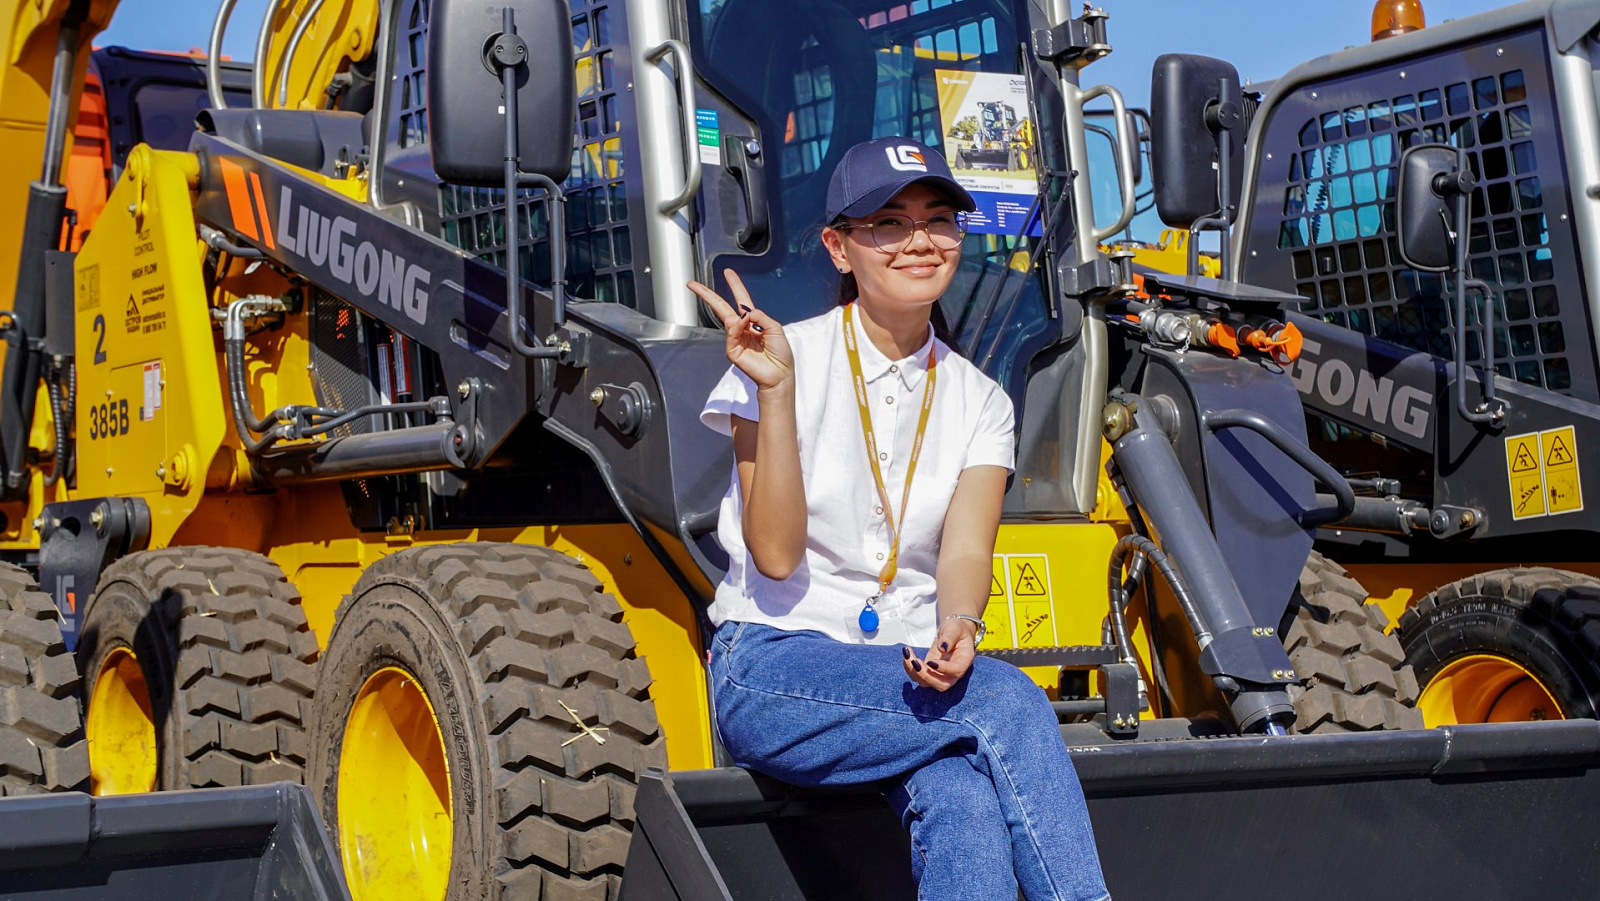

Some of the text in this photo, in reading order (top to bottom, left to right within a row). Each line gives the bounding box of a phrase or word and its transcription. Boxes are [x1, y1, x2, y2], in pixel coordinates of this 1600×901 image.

[131, 262, 158, 280] HIGH FLOW
[93, 314, 107, 365] 2
[90, 398, 129, 440] 385B
